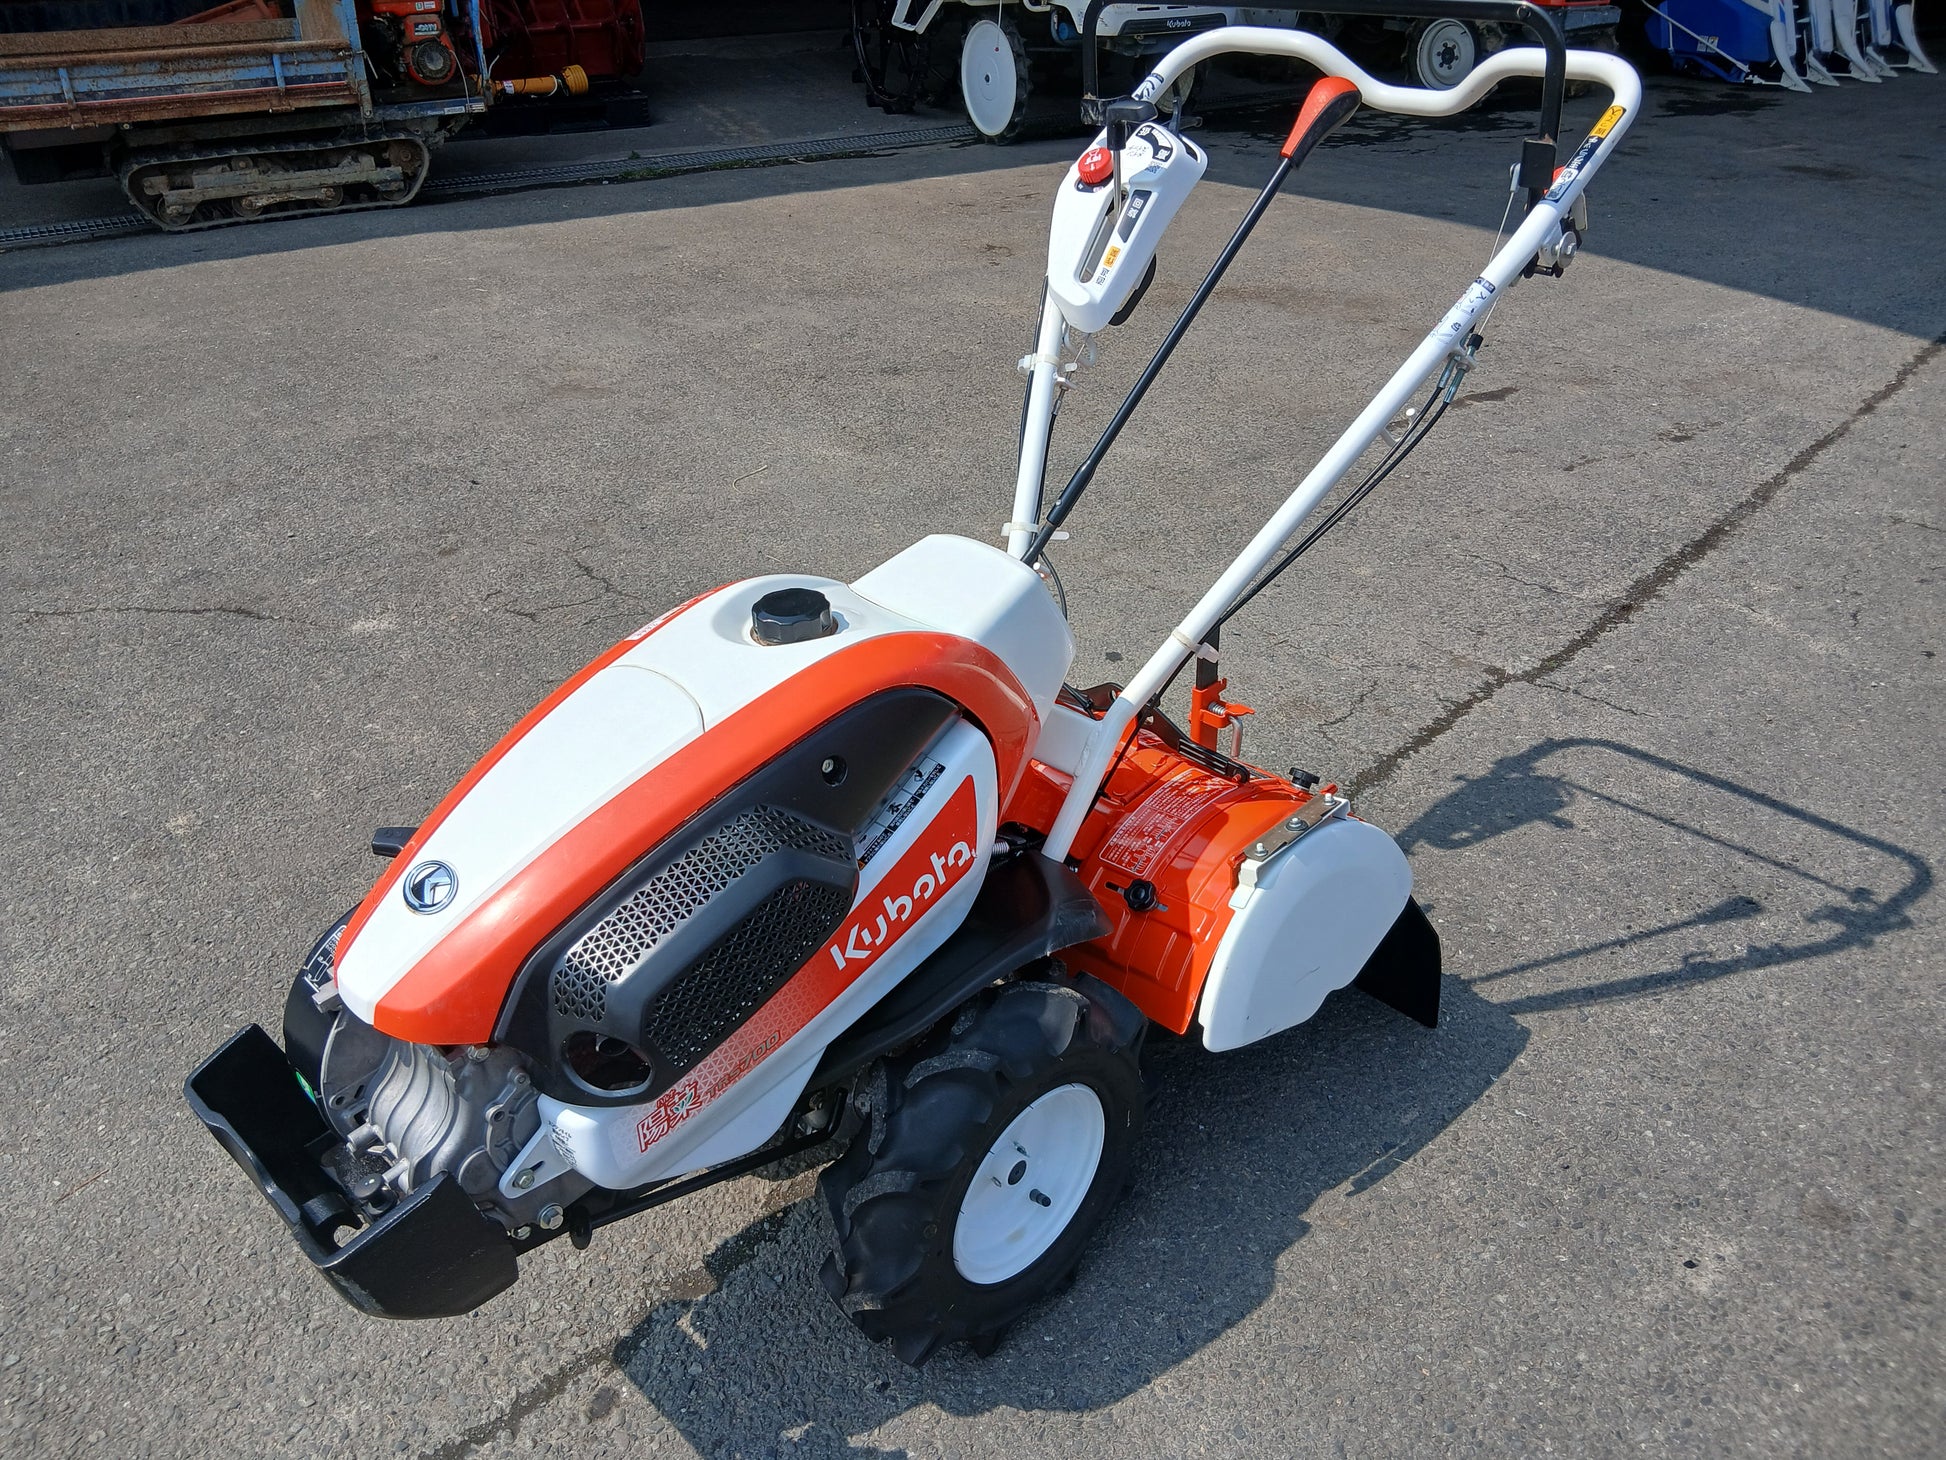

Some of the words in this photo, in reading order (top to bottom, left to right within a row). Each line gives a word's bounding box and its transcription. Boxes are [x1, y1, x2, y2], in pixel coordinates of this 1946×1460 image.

[1167, 19, 1191, 29] Kubota
[830, 841, 976, 971] Kubota
[706, 1029, 780, 1098] TRS700
[637, 1081, 703, 1153] 陽菜
